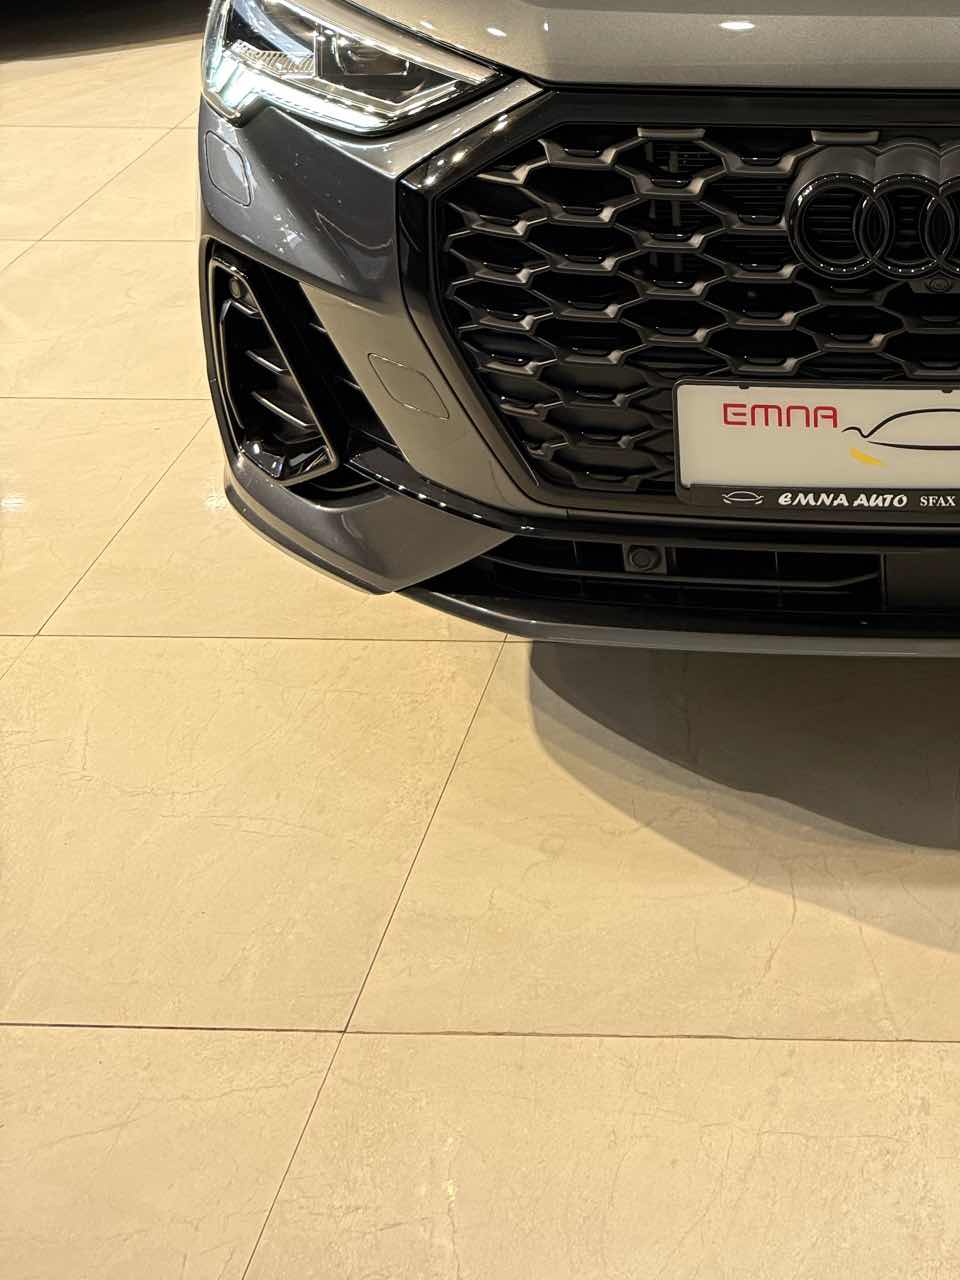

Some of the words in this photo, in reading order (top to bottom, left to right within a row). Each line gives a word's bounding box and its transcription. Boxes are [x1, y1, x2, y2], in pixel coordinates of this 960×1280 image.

[722, 402, 839, 429] EMNA
[852, 493, 908, 508] AUTO
[919, 495, 956, 508] SFAX
